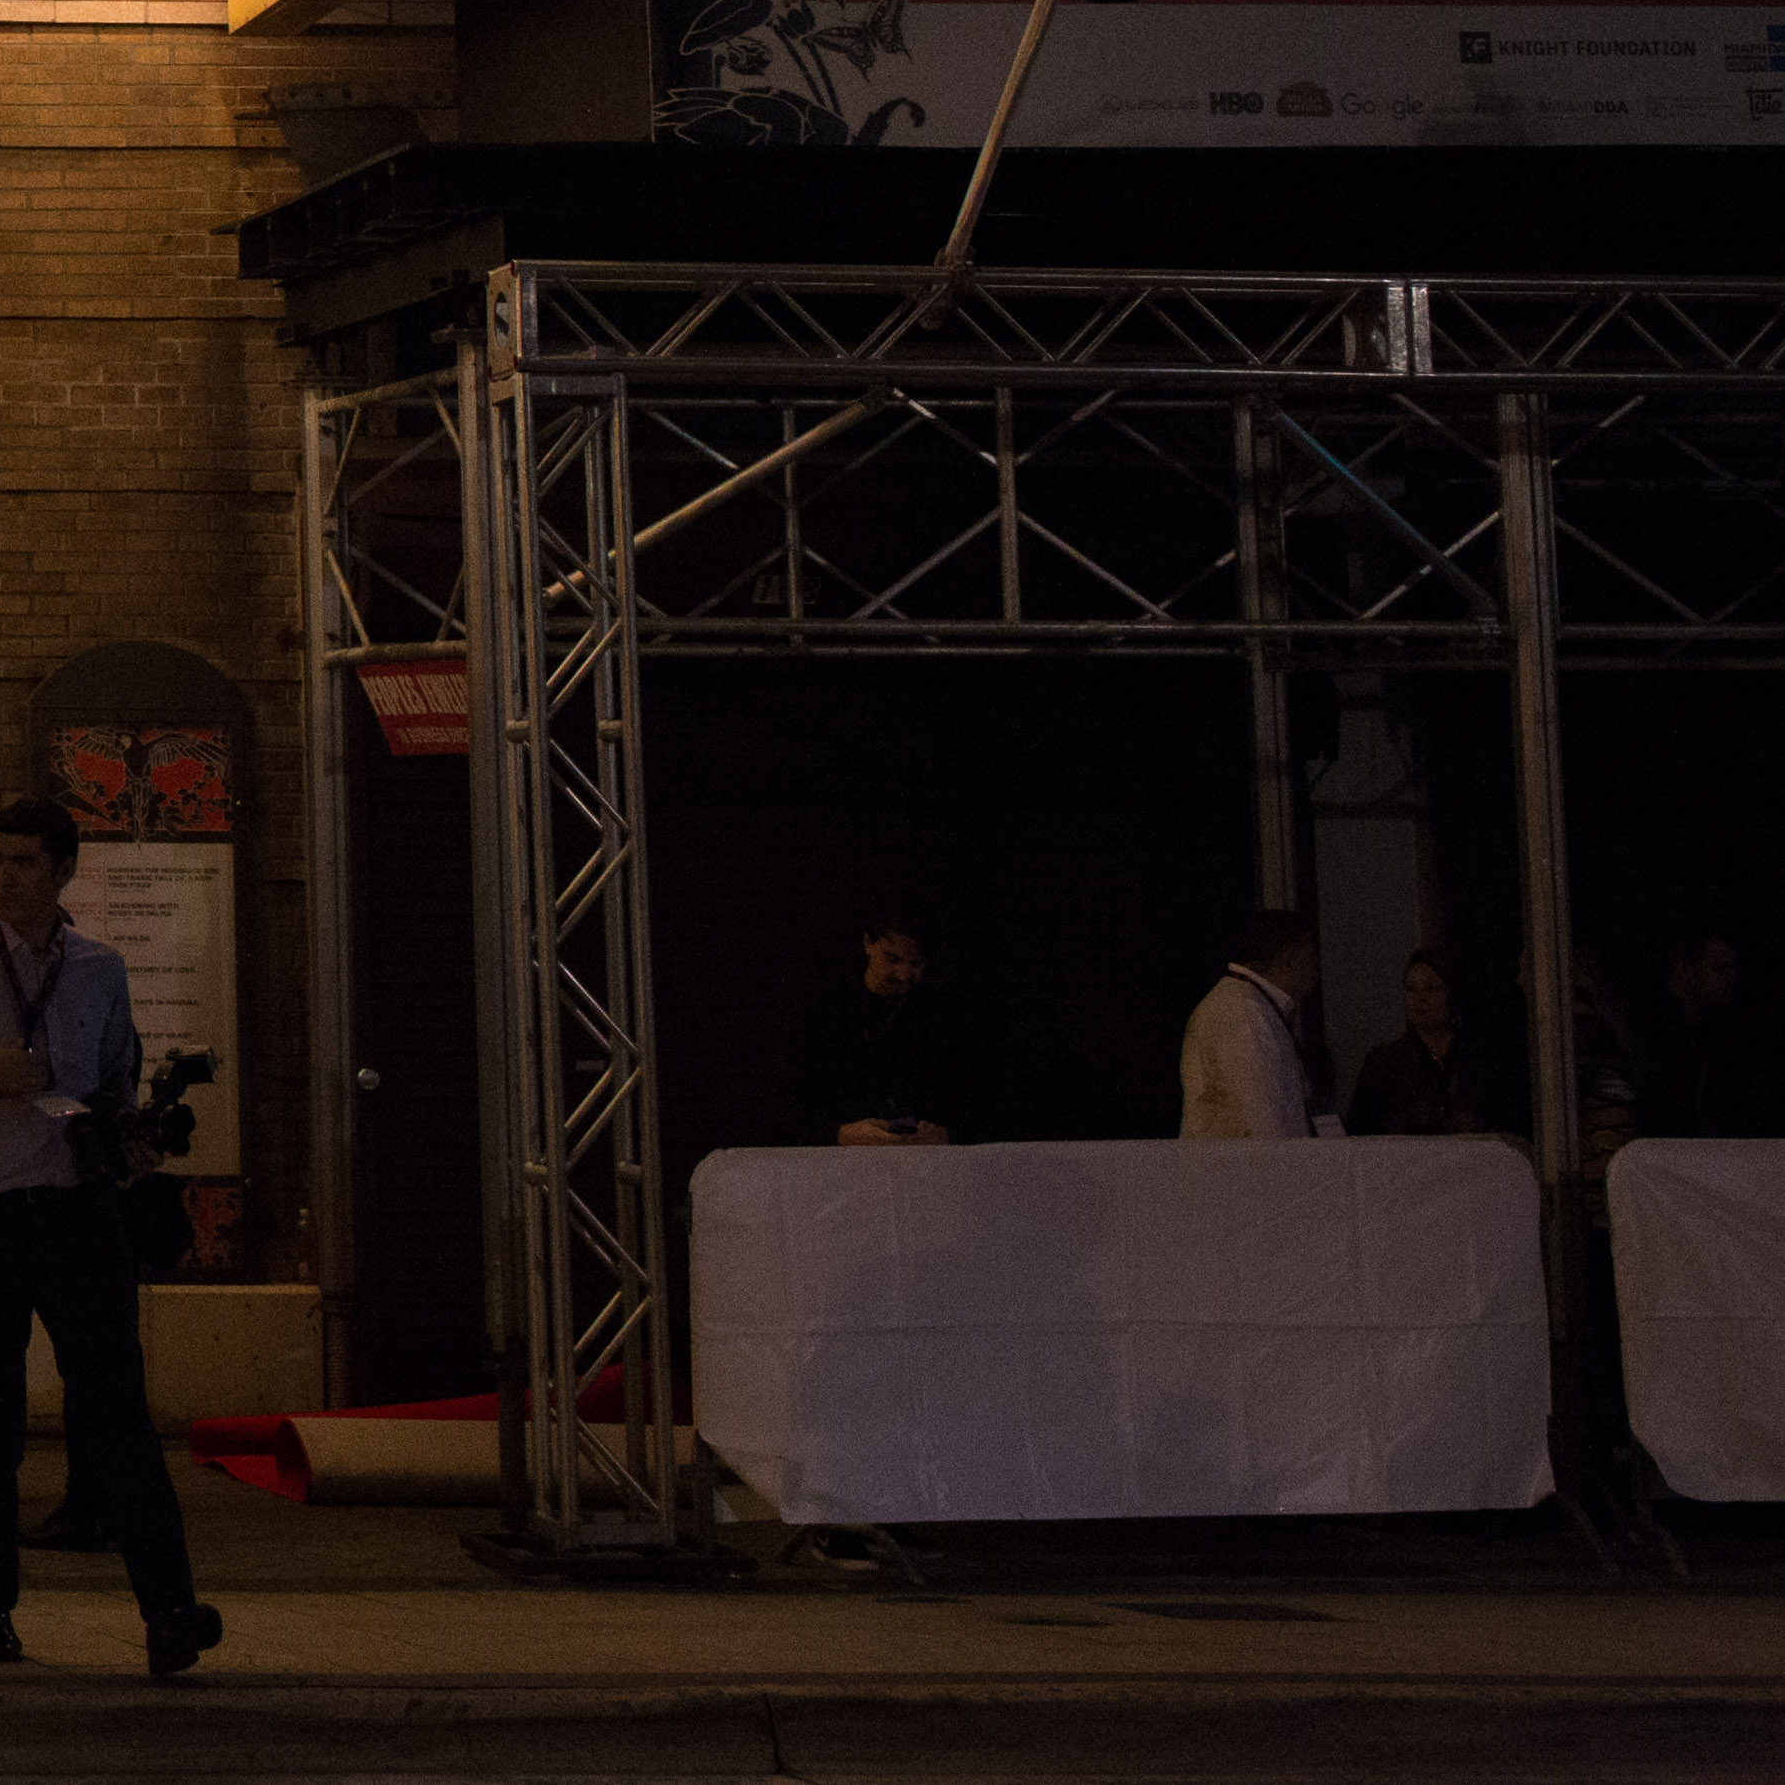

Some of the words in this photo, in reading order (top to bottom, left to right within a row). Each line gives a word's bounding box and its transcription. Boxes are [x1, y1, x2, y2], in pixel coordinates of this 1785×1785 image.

[1499, 41, 1568, 56] KNIGHT
[1577, 41, 1696, 56] FOUNDATION
[1210, 91, 1264, 116] HBO
[1340, 92, 1424, 121] Gogle
